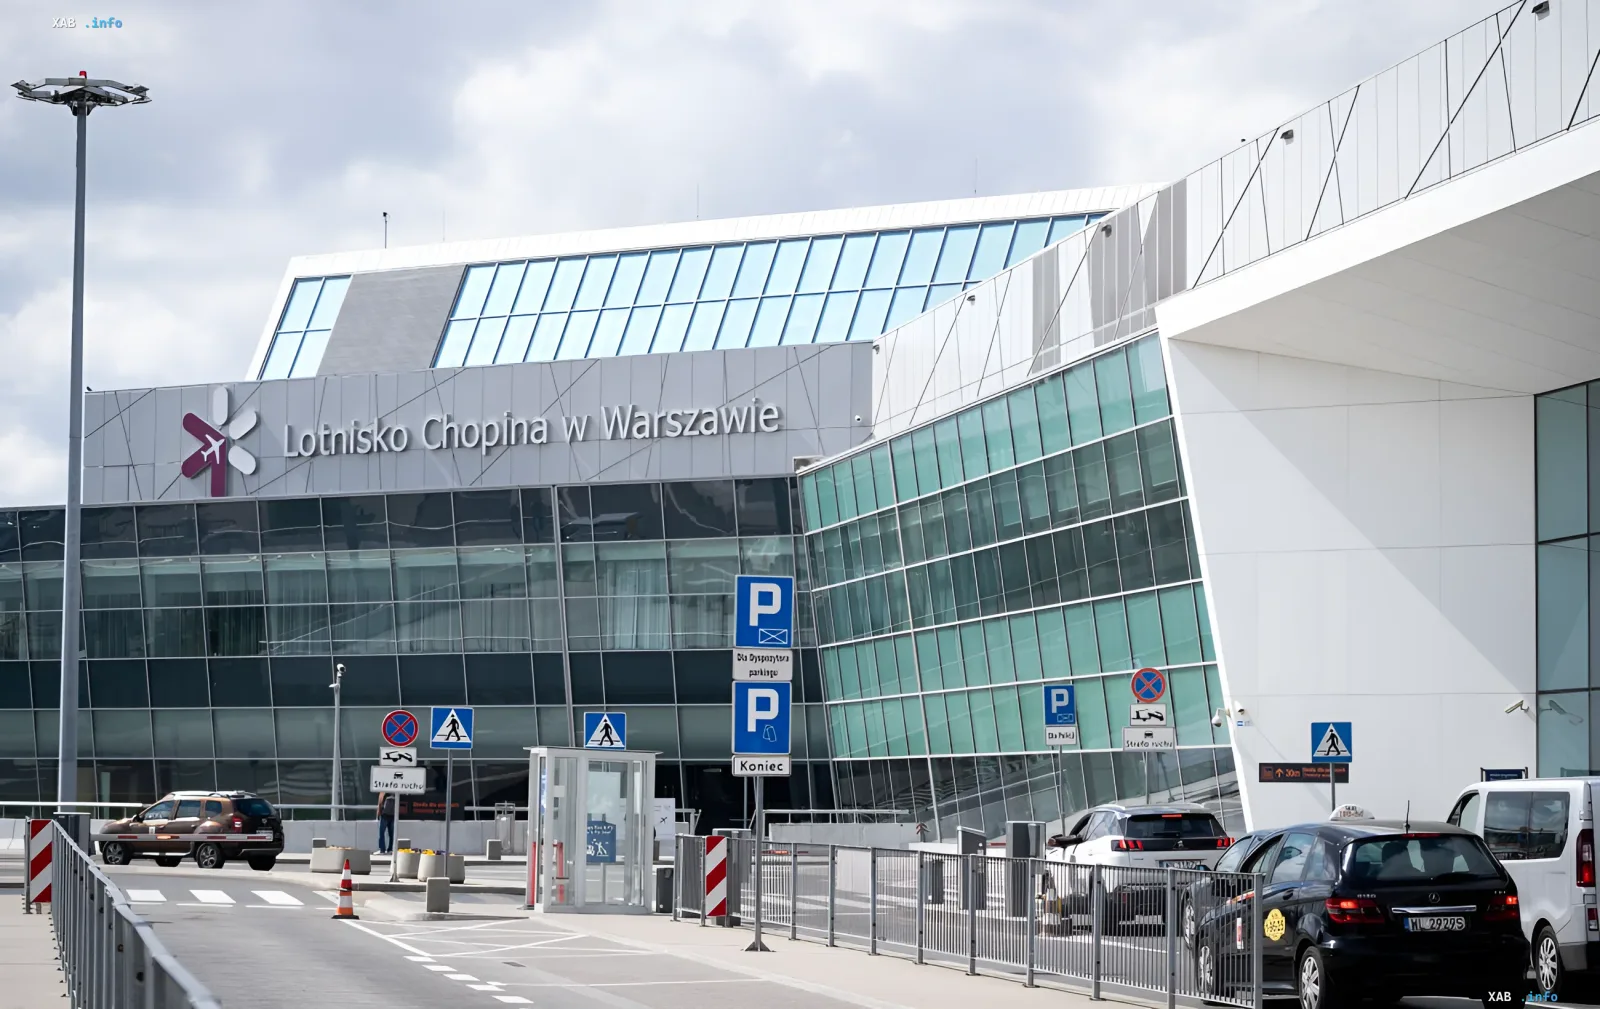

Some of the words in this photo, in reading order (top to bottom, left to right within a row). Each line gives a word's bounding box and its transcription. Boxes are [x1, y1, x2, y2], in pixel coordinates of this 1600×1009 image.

[283, 416, 408, 458] Lotnisko
[423, 410, 548, 456] Chopina
[562, 414, 592, 443] w
[601, 397, 779, 441] Warszawie
[749, 582, 782, 627] P
[748, 667, 779, 679] parkingu
[747, 688, 780, 733] P
[1050, 688, 1069, 714] P
[740, 760, 784, 772] Koniec
